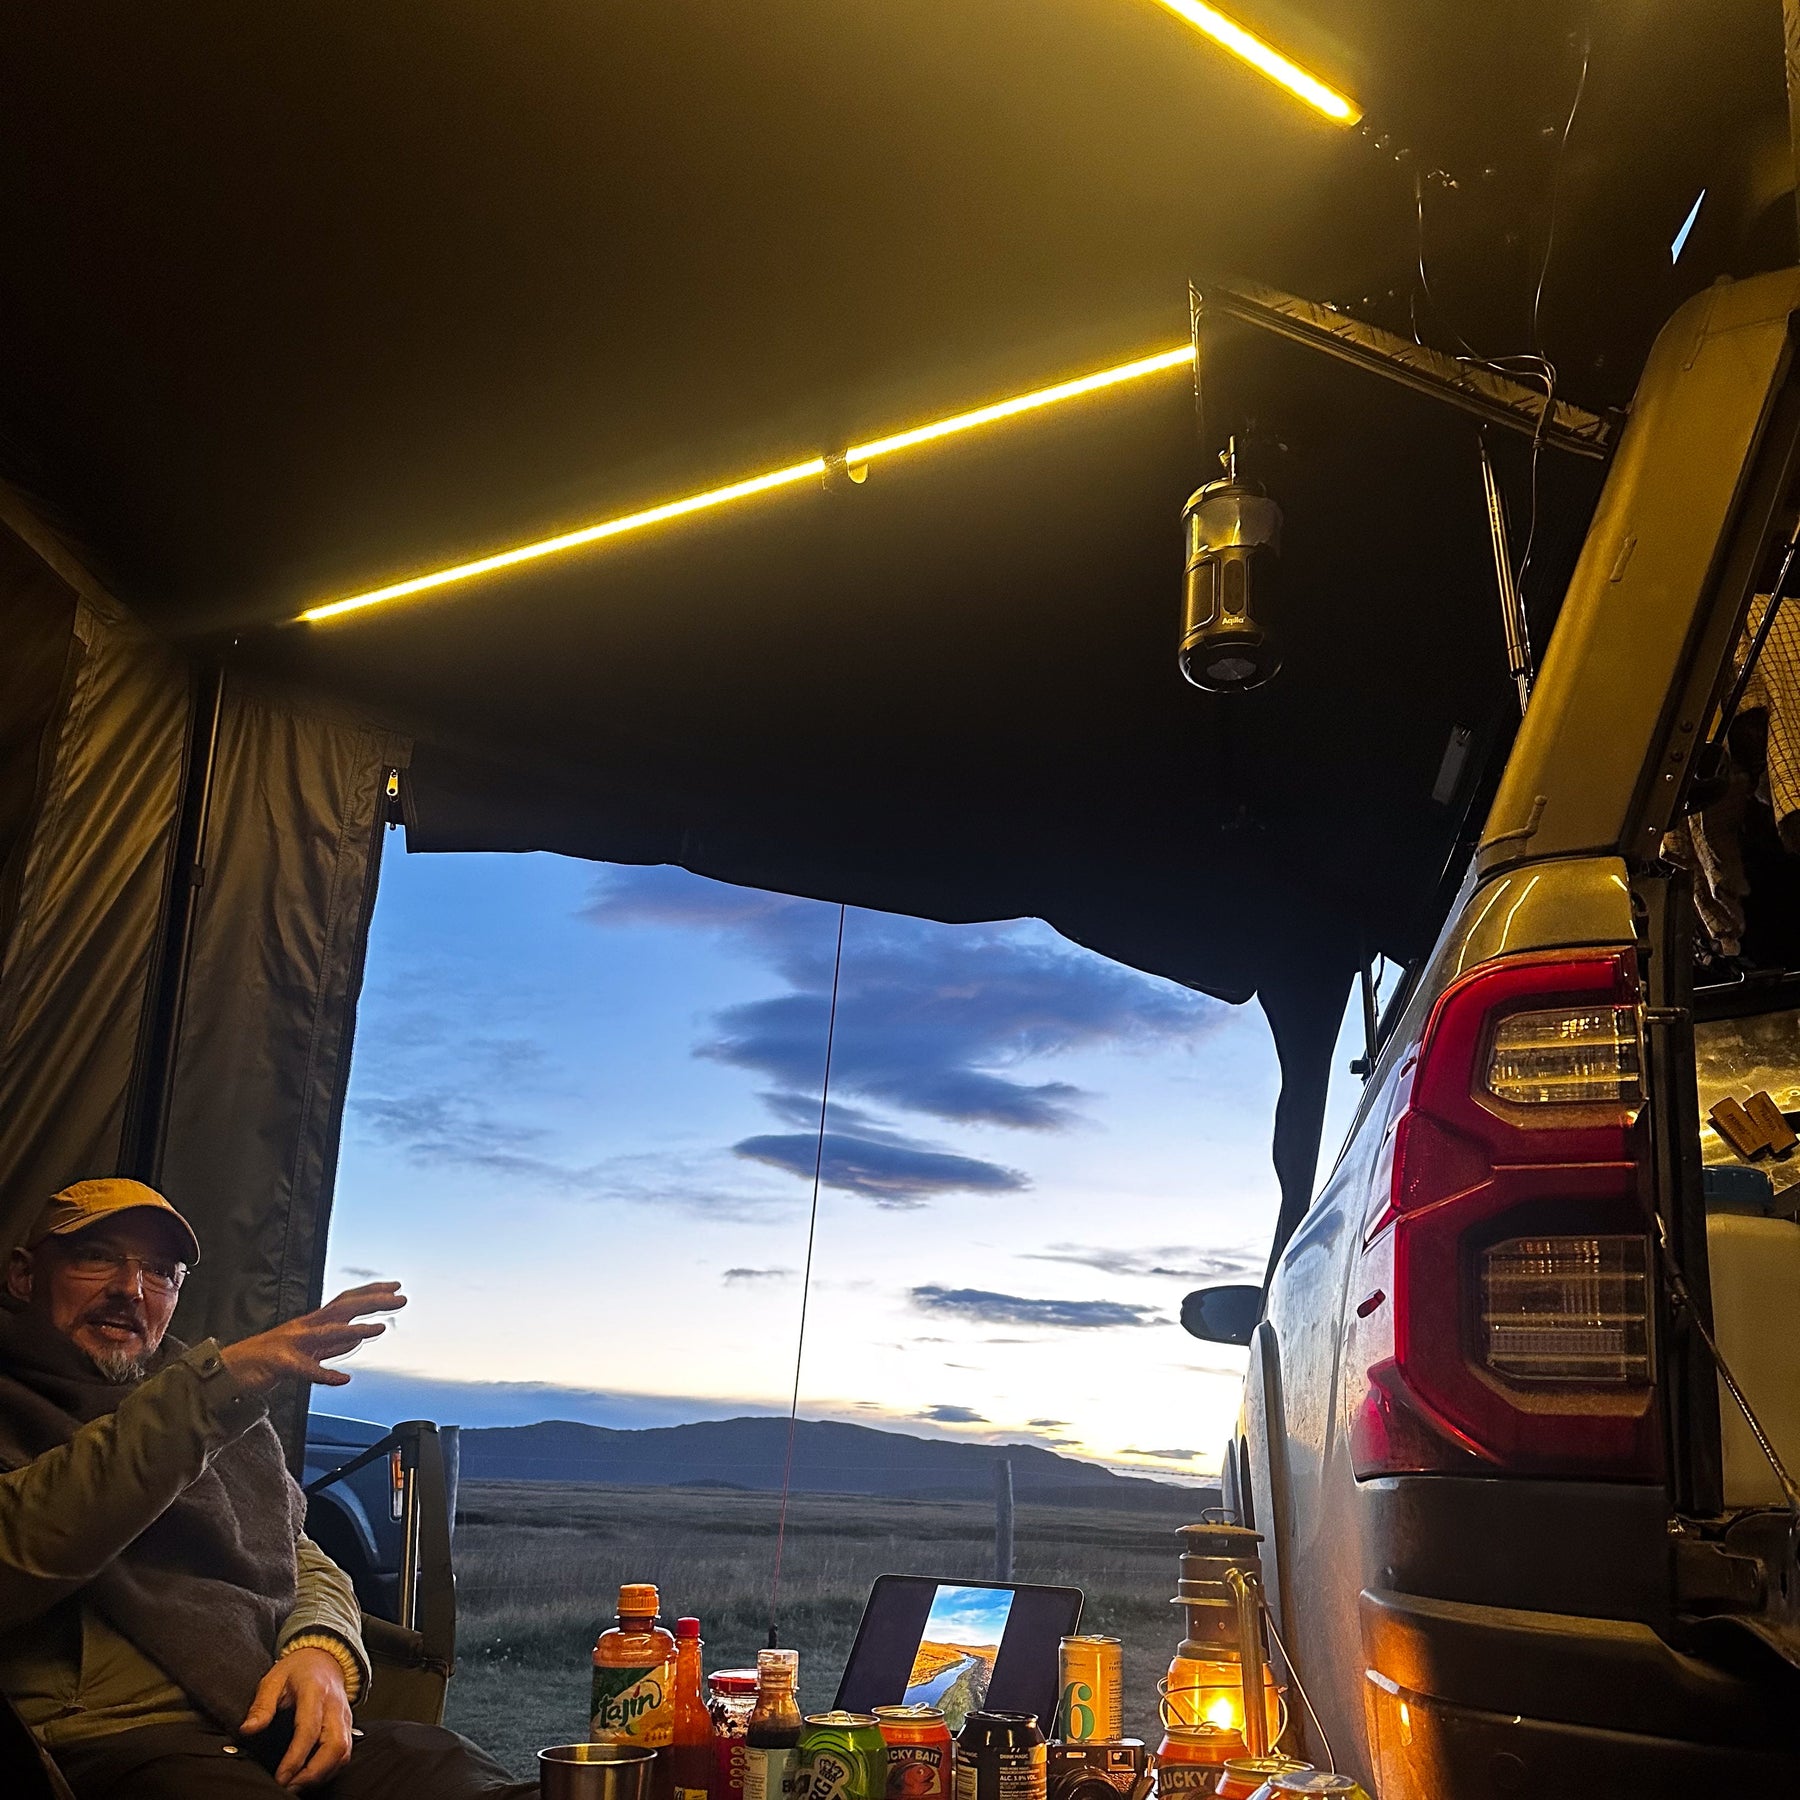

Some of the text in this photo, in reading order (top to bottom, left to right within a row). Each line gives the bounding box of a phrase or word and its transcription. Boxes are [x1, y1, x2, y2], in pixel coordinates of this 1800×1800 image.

[1060, 1682, 1095, 1740] 6
[887, 1749, 940, 1764] CKY BAIT
[1160, 1771, 1208, 1791] LUCKY
